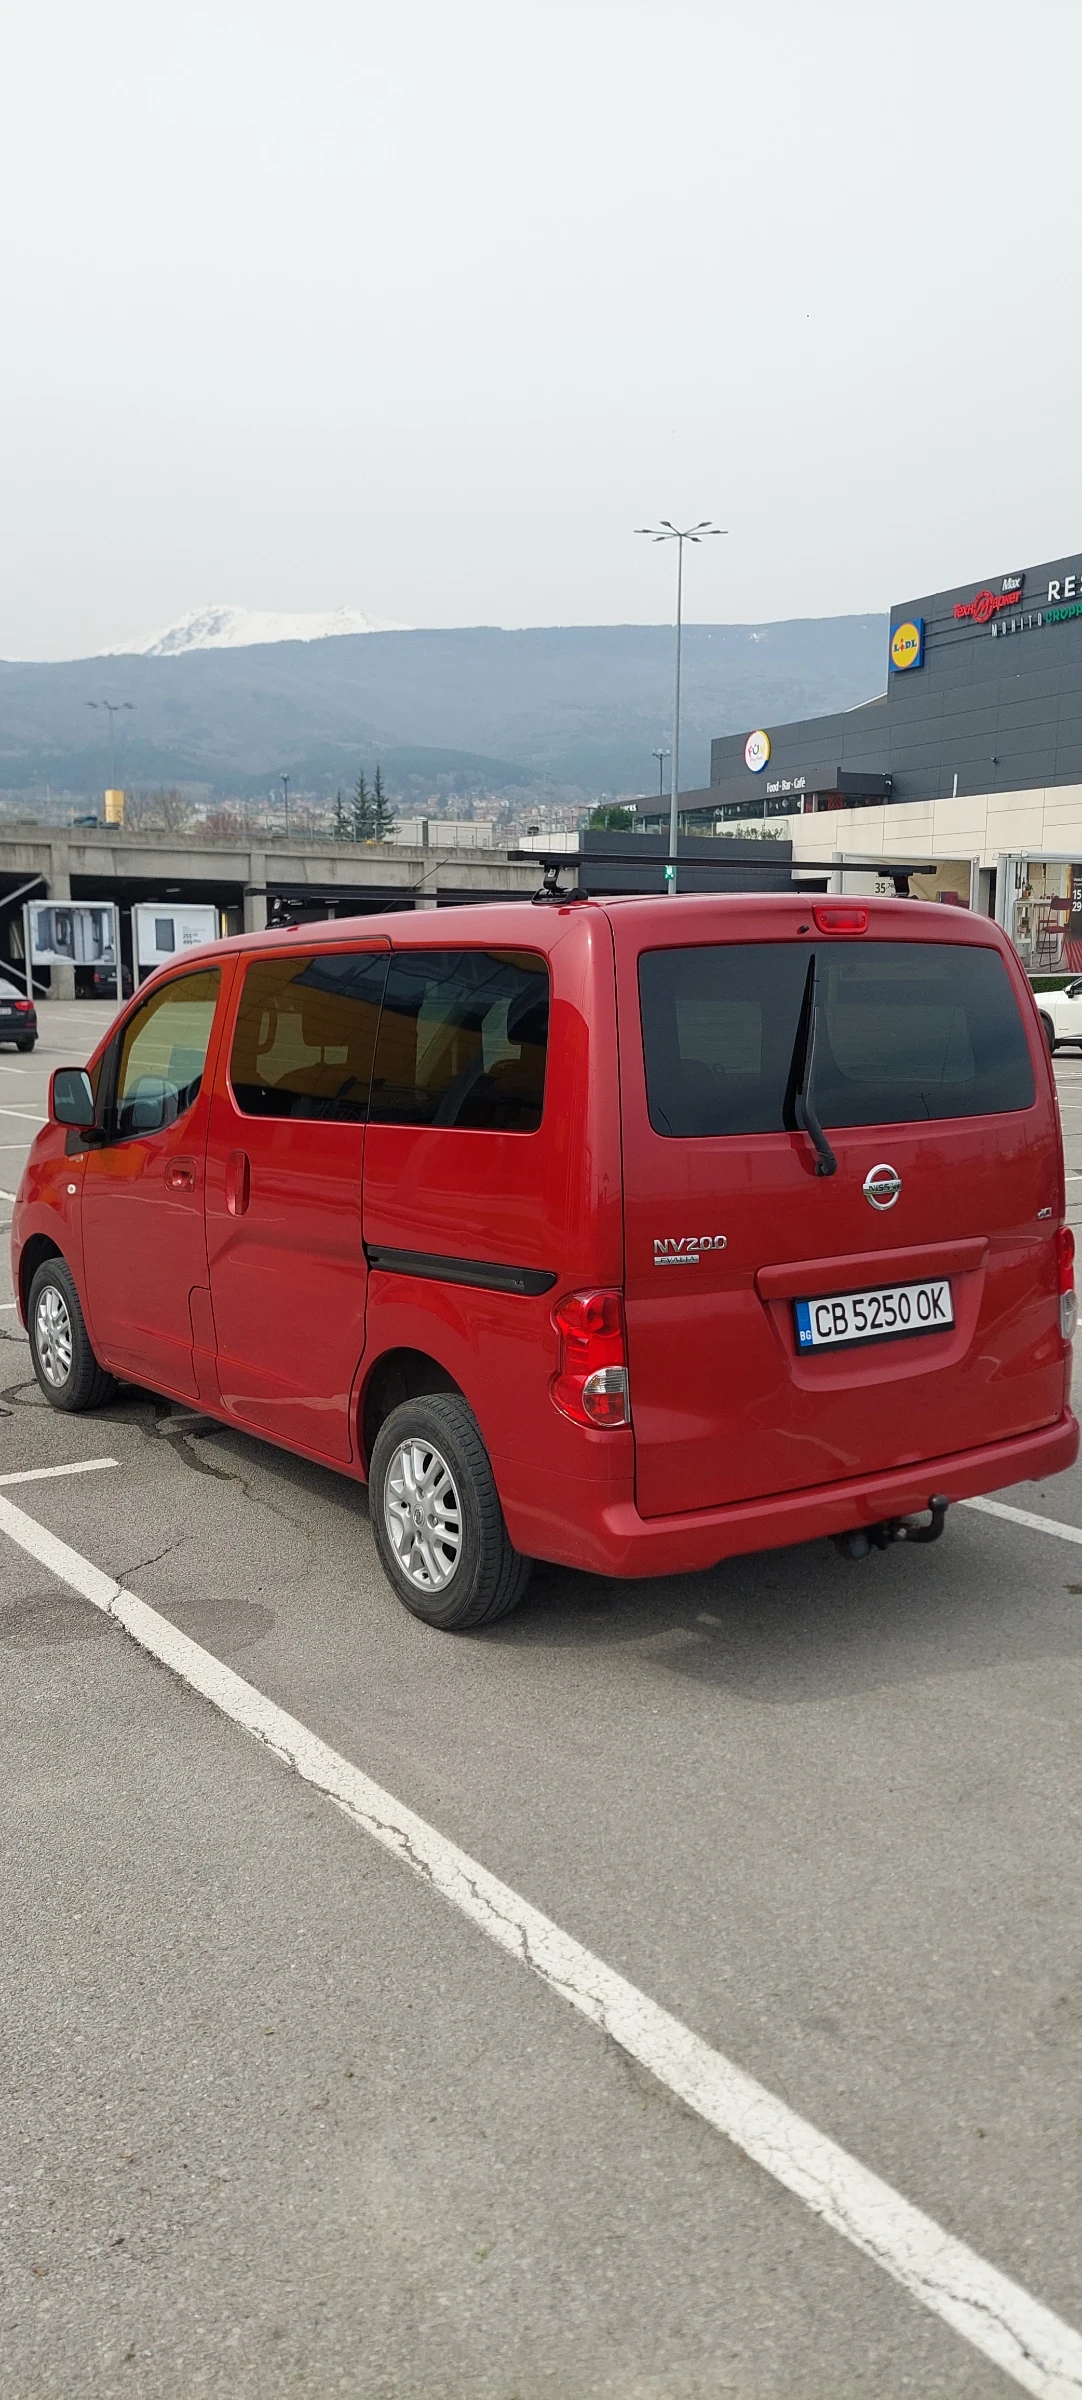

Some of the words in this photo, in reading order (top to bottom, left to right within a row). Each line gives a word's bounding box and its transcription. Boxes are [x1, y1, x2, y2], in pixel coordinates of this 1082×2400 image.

[1002, 577, 1021, 591] Max
[1048, 575, 1082, 602] RE
[991, 612, 1043, 637] MOHITO
[766, 780, 780, 793] Food
[653, 1236, 728, 1254] NV200
[815, 1302, 848, 1338] CB
[852, 1292, 911, 1332] 5250
[916, 1286, 947, 1321] OK
[799, 1330, 812, 1341] BG
